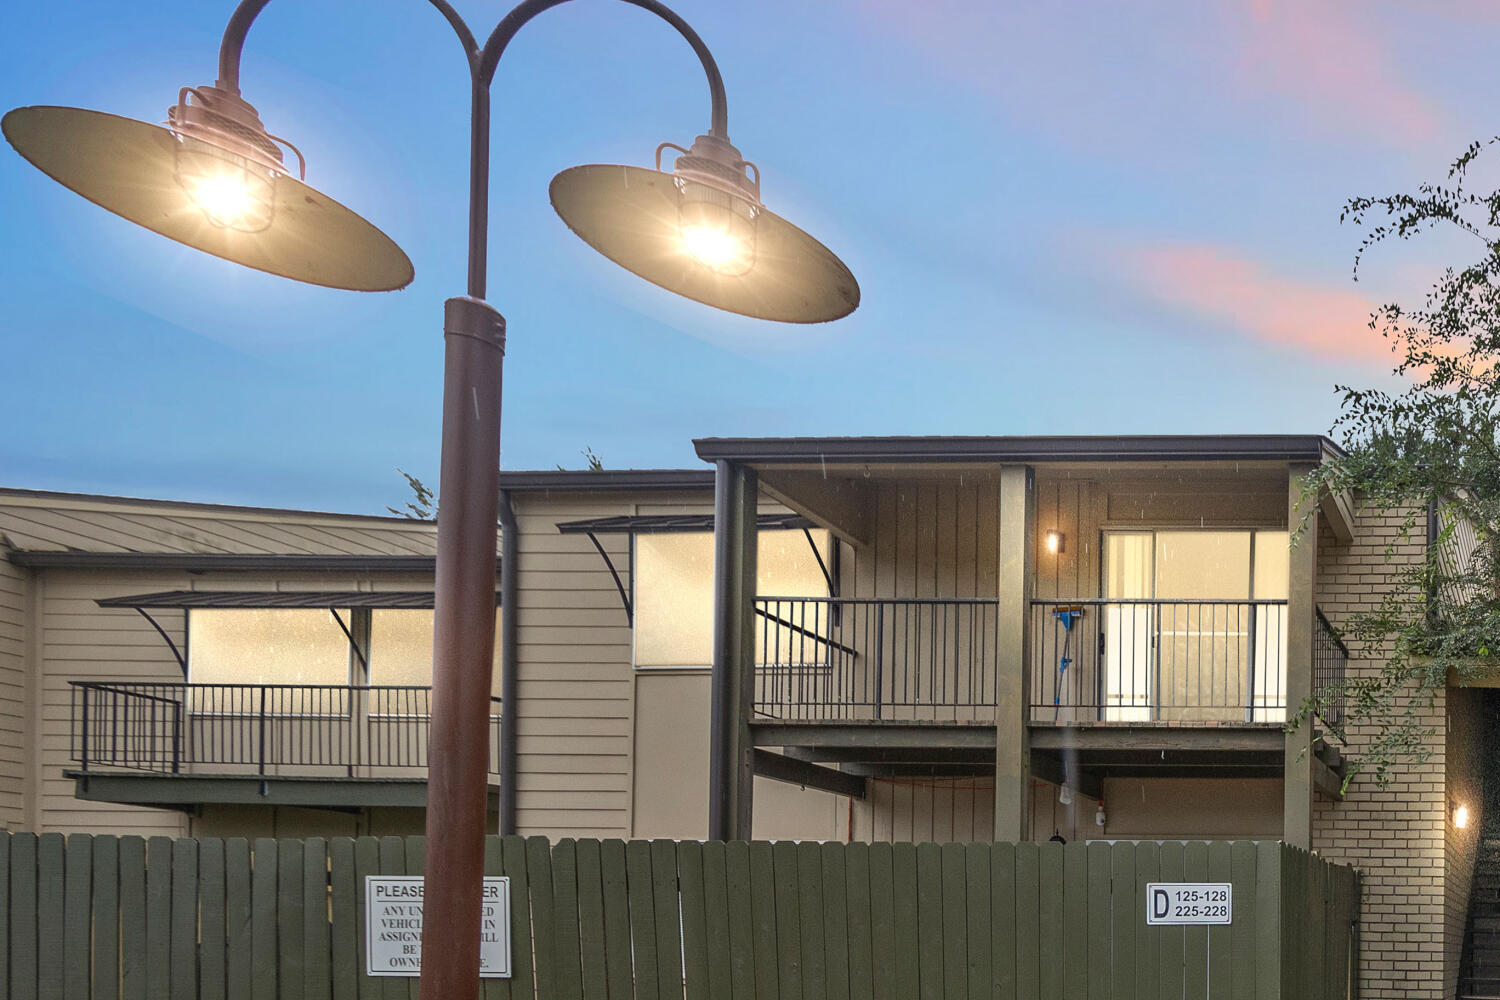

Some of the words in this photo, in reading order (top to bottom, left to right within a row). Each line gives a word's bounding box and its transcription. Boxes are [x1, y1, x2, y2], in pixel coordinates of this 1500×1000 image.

[376, 885, 424, 897] PLEASE
[1175, 890, 1227, 902] 125-128
[1153, 889, 1169, 918] D
[383, 906, 406, 916] ANY
[1175, 905, 1227, 917] 225-228
[380, 918, 423, 929] VEHICL
[484, 920, 496, 929] IN
[379, 932, 423, 942] ASSIGN
[403, 944, 417, 955] BE
